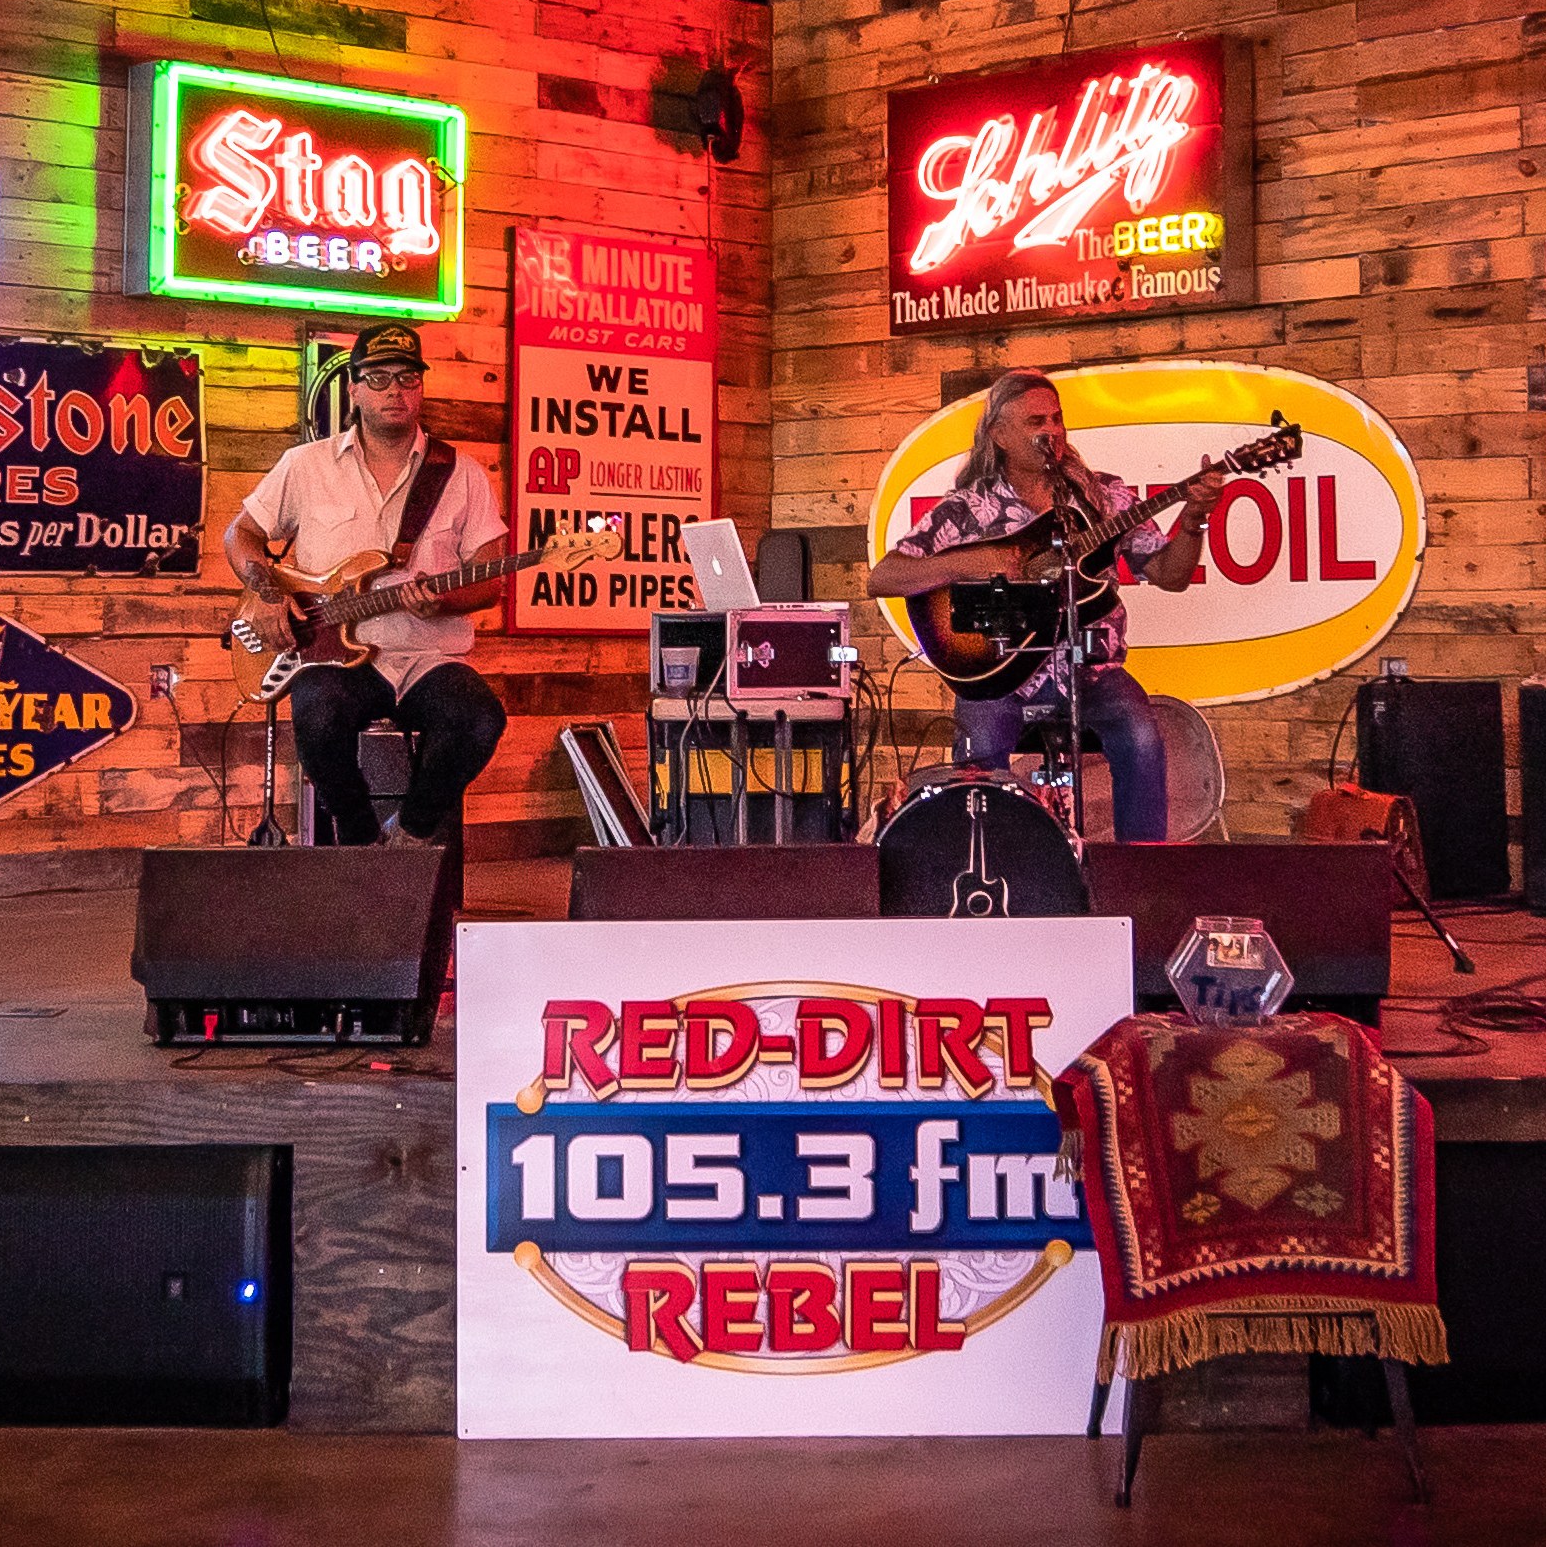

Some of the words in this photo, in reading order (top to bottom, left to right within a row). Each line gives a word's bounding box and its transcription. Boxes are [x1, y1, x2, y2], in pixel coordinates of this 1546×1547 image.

[187, 108, 441, 256] Stag
[909, 62, 1194, 275] Schlitz
[251, 229, 382, 274] BEER
[1075, 227, 1114, 263] The
[1113, 210, 1225, 258] BEER
[581, 244, 694, 296] MINUTE
[892, 289, 940, 325] That
[942, 283, 1000, 319] Made
[1004, 270, 1126, 313] Milwaukee
[1130, 264, 1222, 300] Famous
[531, 286, 704, 333] INSTALLATION
[548, 325, 614, 346] MOST
[624, 332, 688, 353] CARS
[585, 363, 650, 397] WE
[530, 396, 703, 445] INSTALL
[525, 445, 581, 496] AP
[589, 459, 643, 491] LONGER
[649, 464, 703, 495] LASTING
[20, 519, 75, 557] per
[76, 512, 189, 550] Dollar
[530, 571, 599, 608] AND
[609, 573, 696, 609] PIPES
[541, 997, 1055, 1102] RED-DIRT
[510, 1131, 877, 1224] 105.3
[908, 1118, 1081, 1235] fm
[622, 1261, 968, 1364] REBEL
